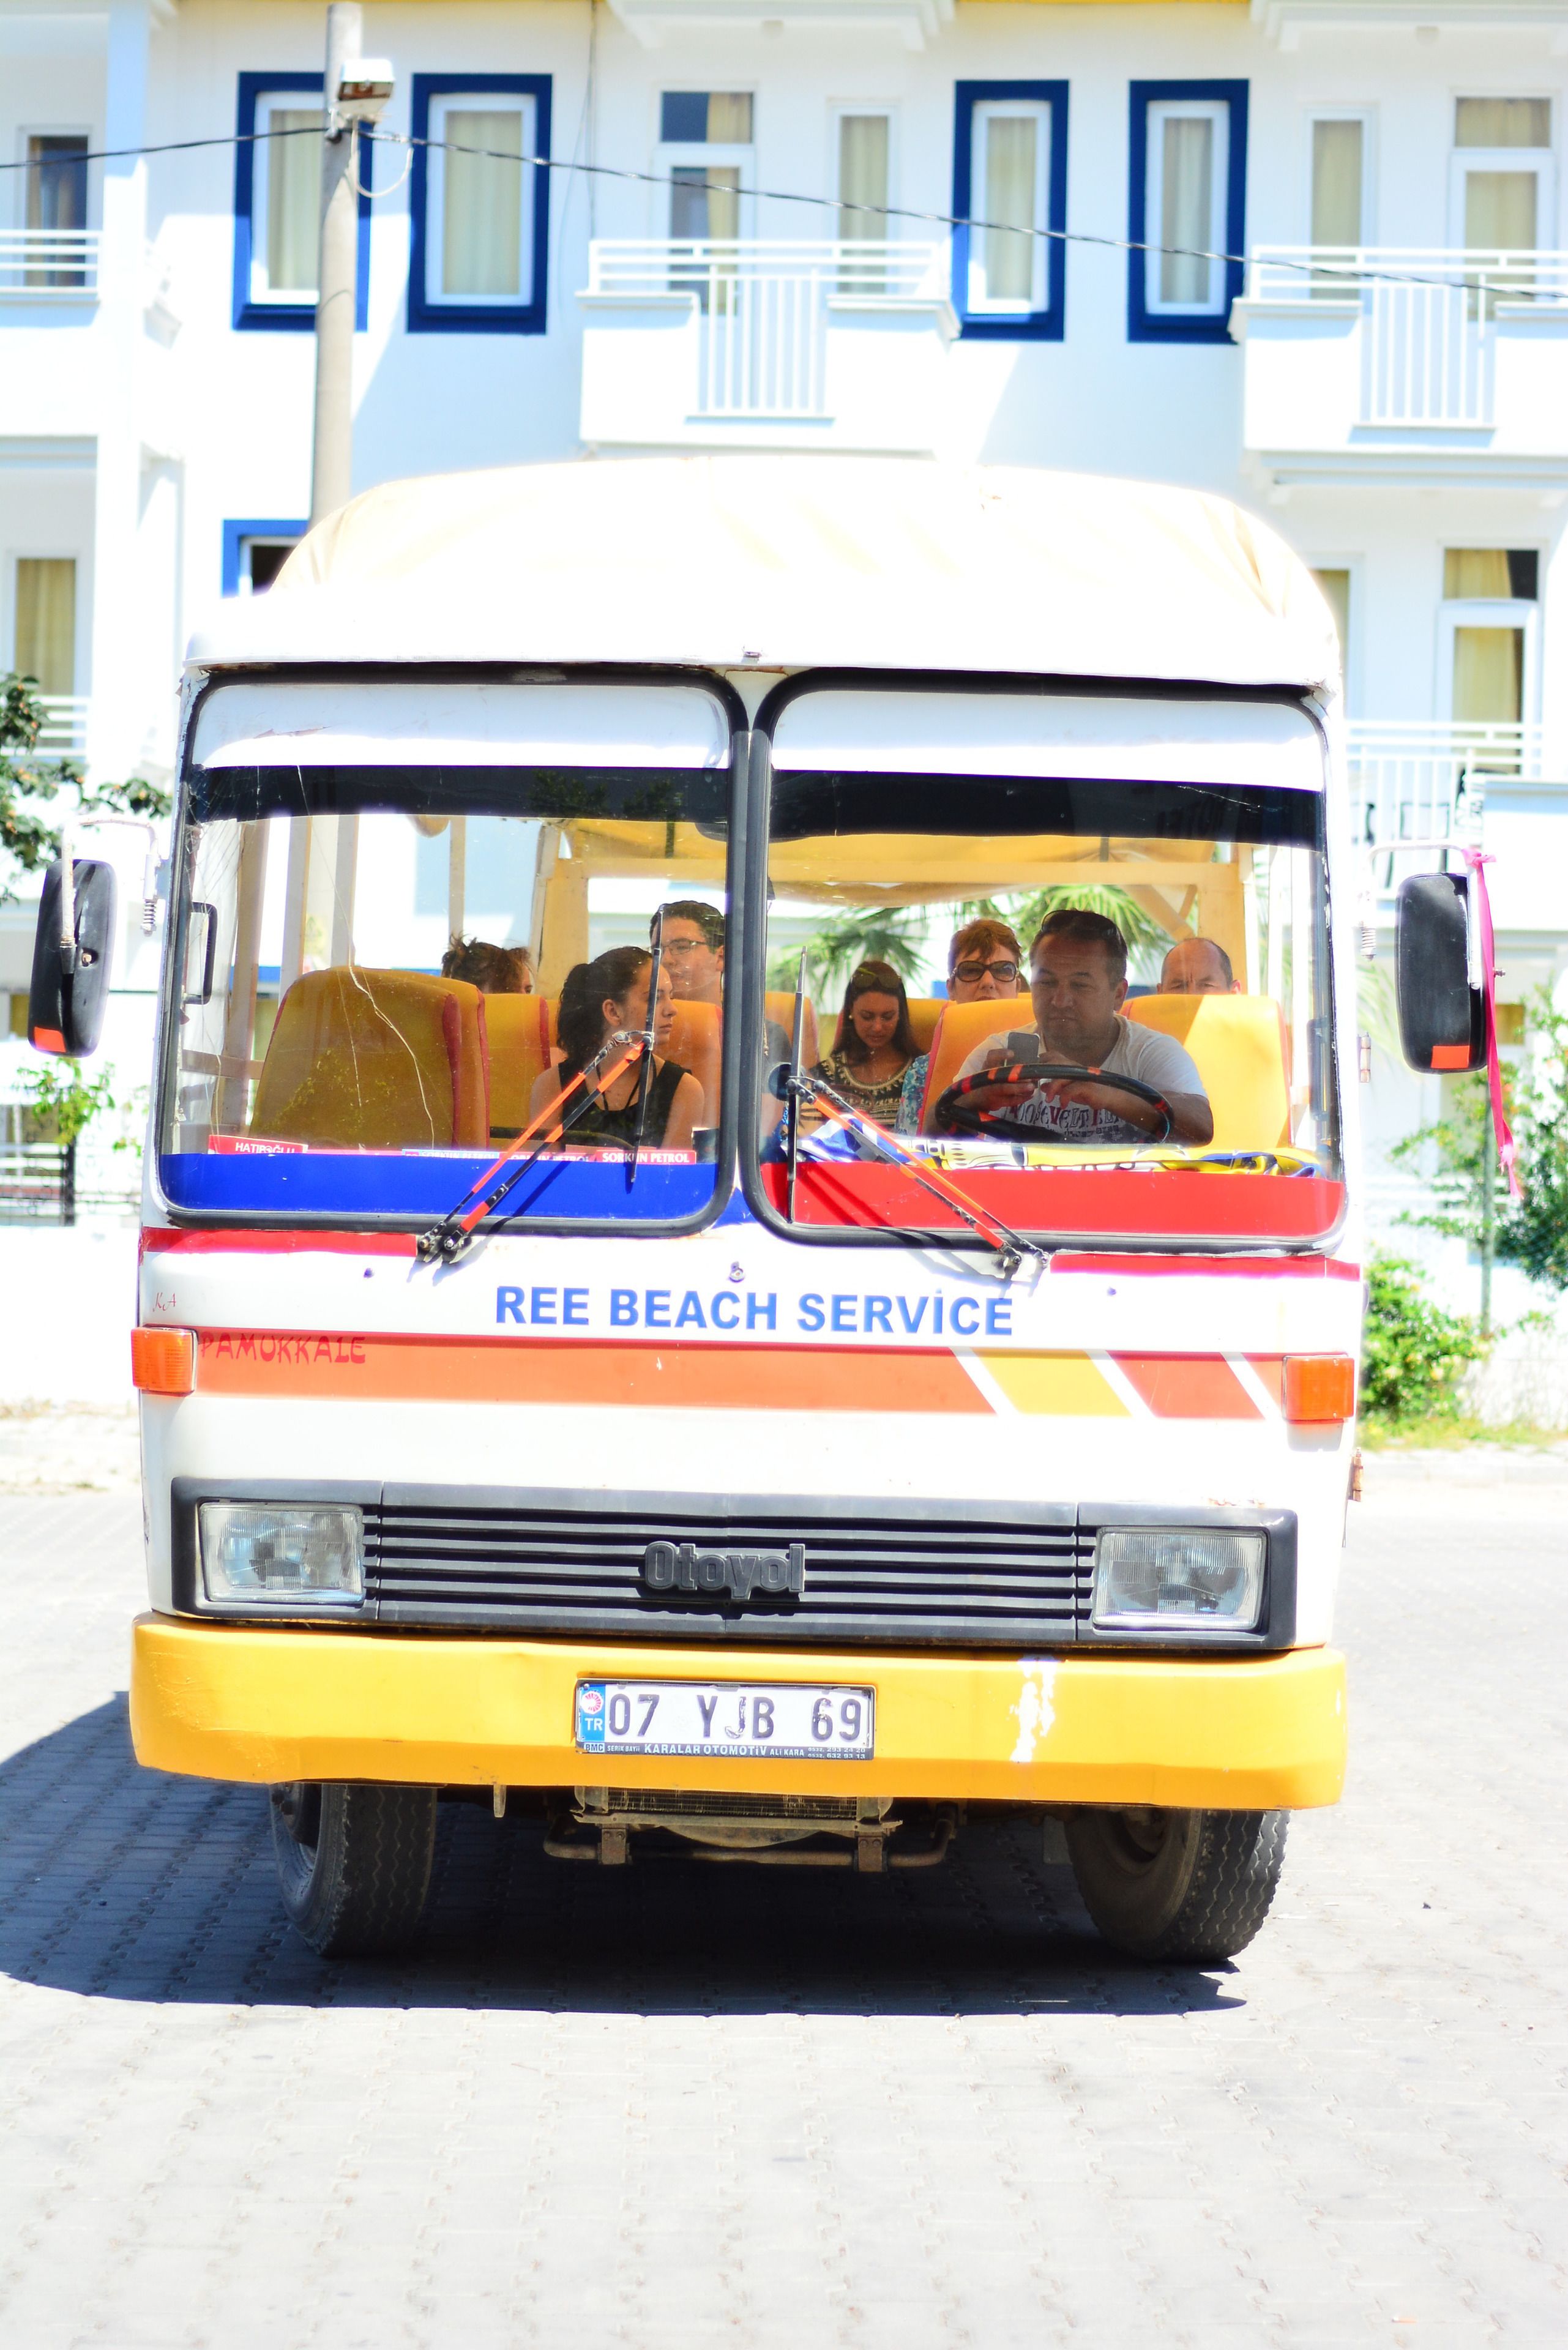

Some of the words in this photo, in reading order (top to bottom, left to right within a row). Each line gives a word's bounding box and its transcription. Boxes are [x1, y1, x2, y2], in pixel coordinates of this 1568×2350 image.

[651, 1153, 690, 1163] PETROL
[496, 1286, 589, 1326] REE
[610, 1288, 777, 1330] BEACH
[200, 1330, 365, 1365] PAMUKKALE
[645, 1540, 805, 1600] Otoyol
[584, 1717, 603, 1731] TR
[609, 1693, 660, 1737] 07
[812, 1697, 862, 1741] 69
[585, 1743, 604, 1752] BMC
[644, 1744, 700, 1755] KARALAR
